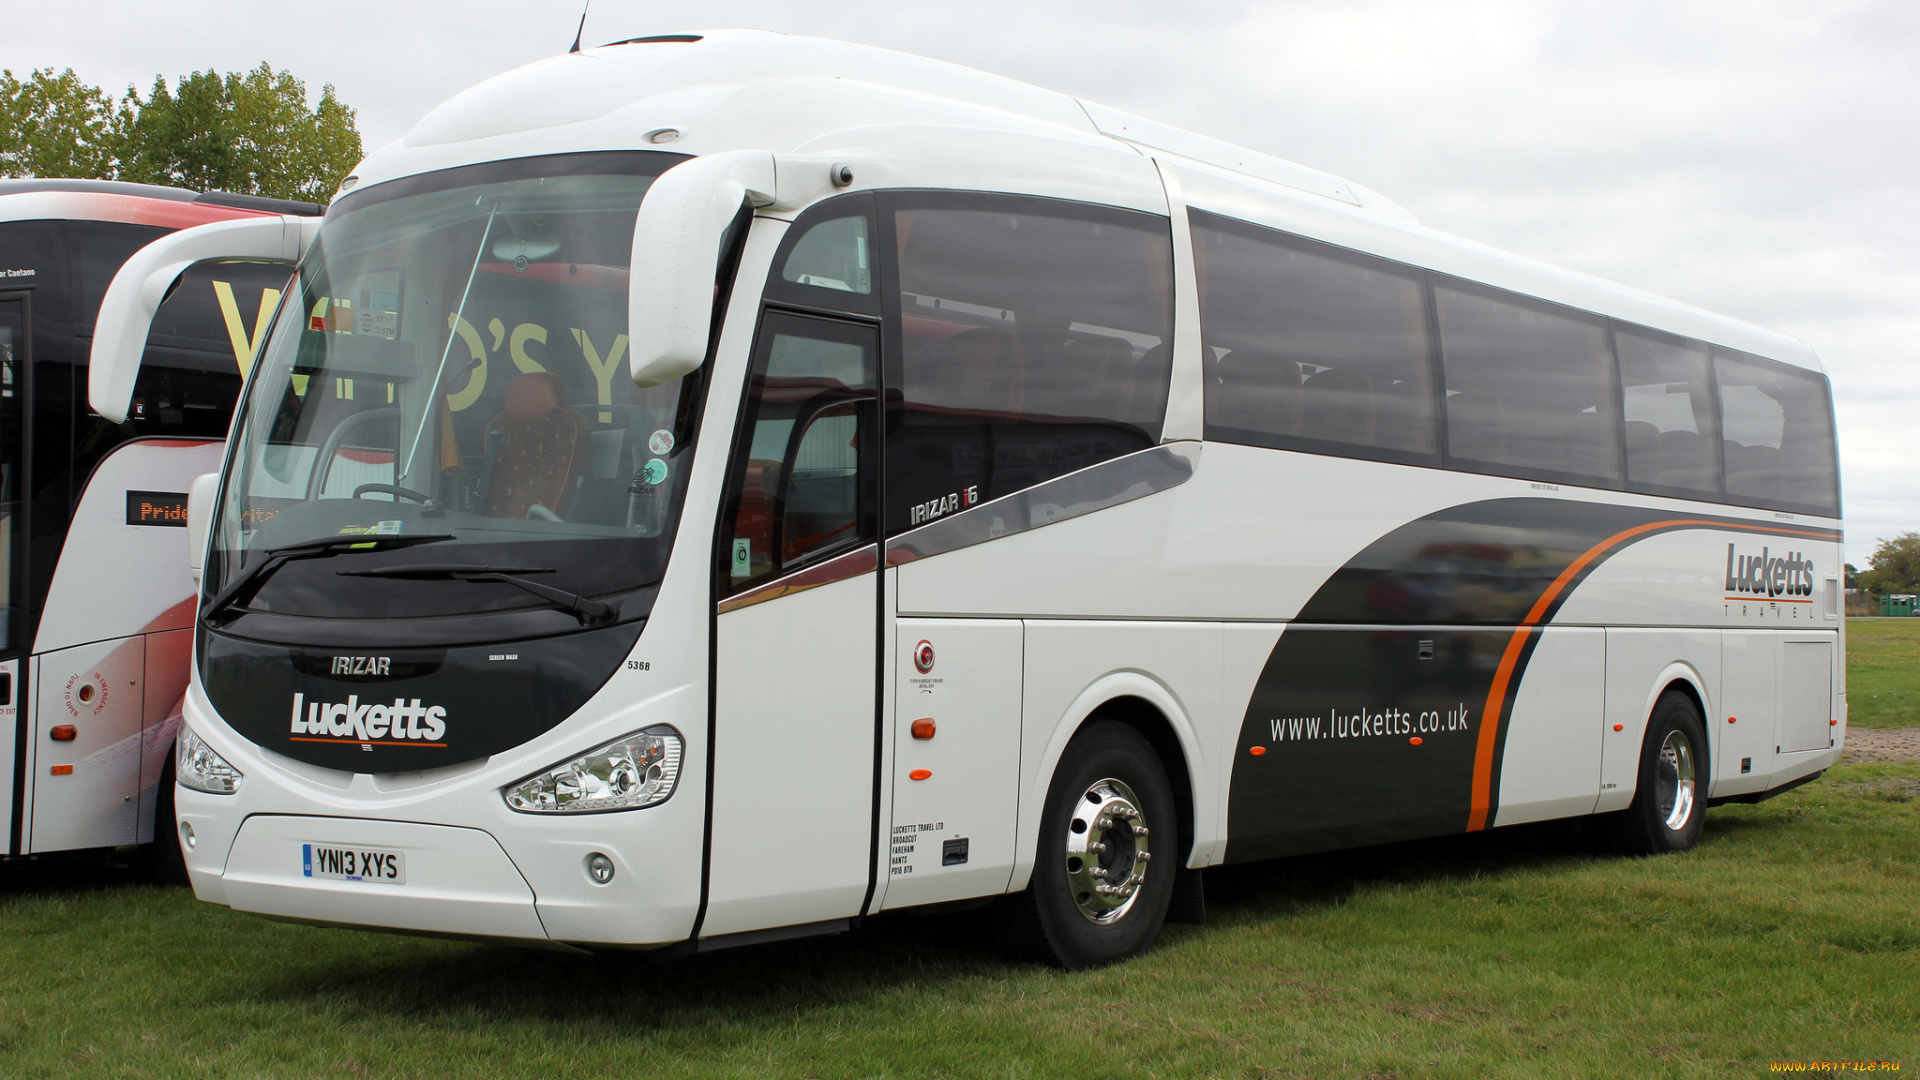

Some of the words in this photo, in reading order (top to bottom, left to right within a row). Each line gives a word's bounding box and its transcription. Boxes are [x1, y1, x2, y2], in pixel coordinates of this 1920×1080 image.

[7, 269, 36, 278] Caetano
[911, 493, 958, 525] IRIZAR
[963, 485, 978, 507] i6
[1725, 543, 1813, 597] Lucketts
[1724, 604, 1813, 619] TRAVEL
[331, 656, 391, 675] IRIZAR
[627, 660, 651, 671] 5368
[66, 673, 79, 689] TURN
[94, 672, 101, 680] IN
[64, 691, 70, 700] TO
[93, 678, 109, 716] EMERGENCY
[65, 701, 79, 717] OPEN
[290, 692, 447, 741] Lucketts
[1270, 702, 1468, 741] www.lucketts.co.uk
[893, 825, 916, 834] LUCKETTS
[918, 823, 934, 832] TRAVEL
[936, 822, 944, 830] LTD
[893, 835, 917, 844] BROADCUT
[892, 845, 914, 854] FAREHAM
[317, 848, 356, 875] YN13
[361, 852, 398, 879] XYS
[892, 856, 907, 864] HANTS
